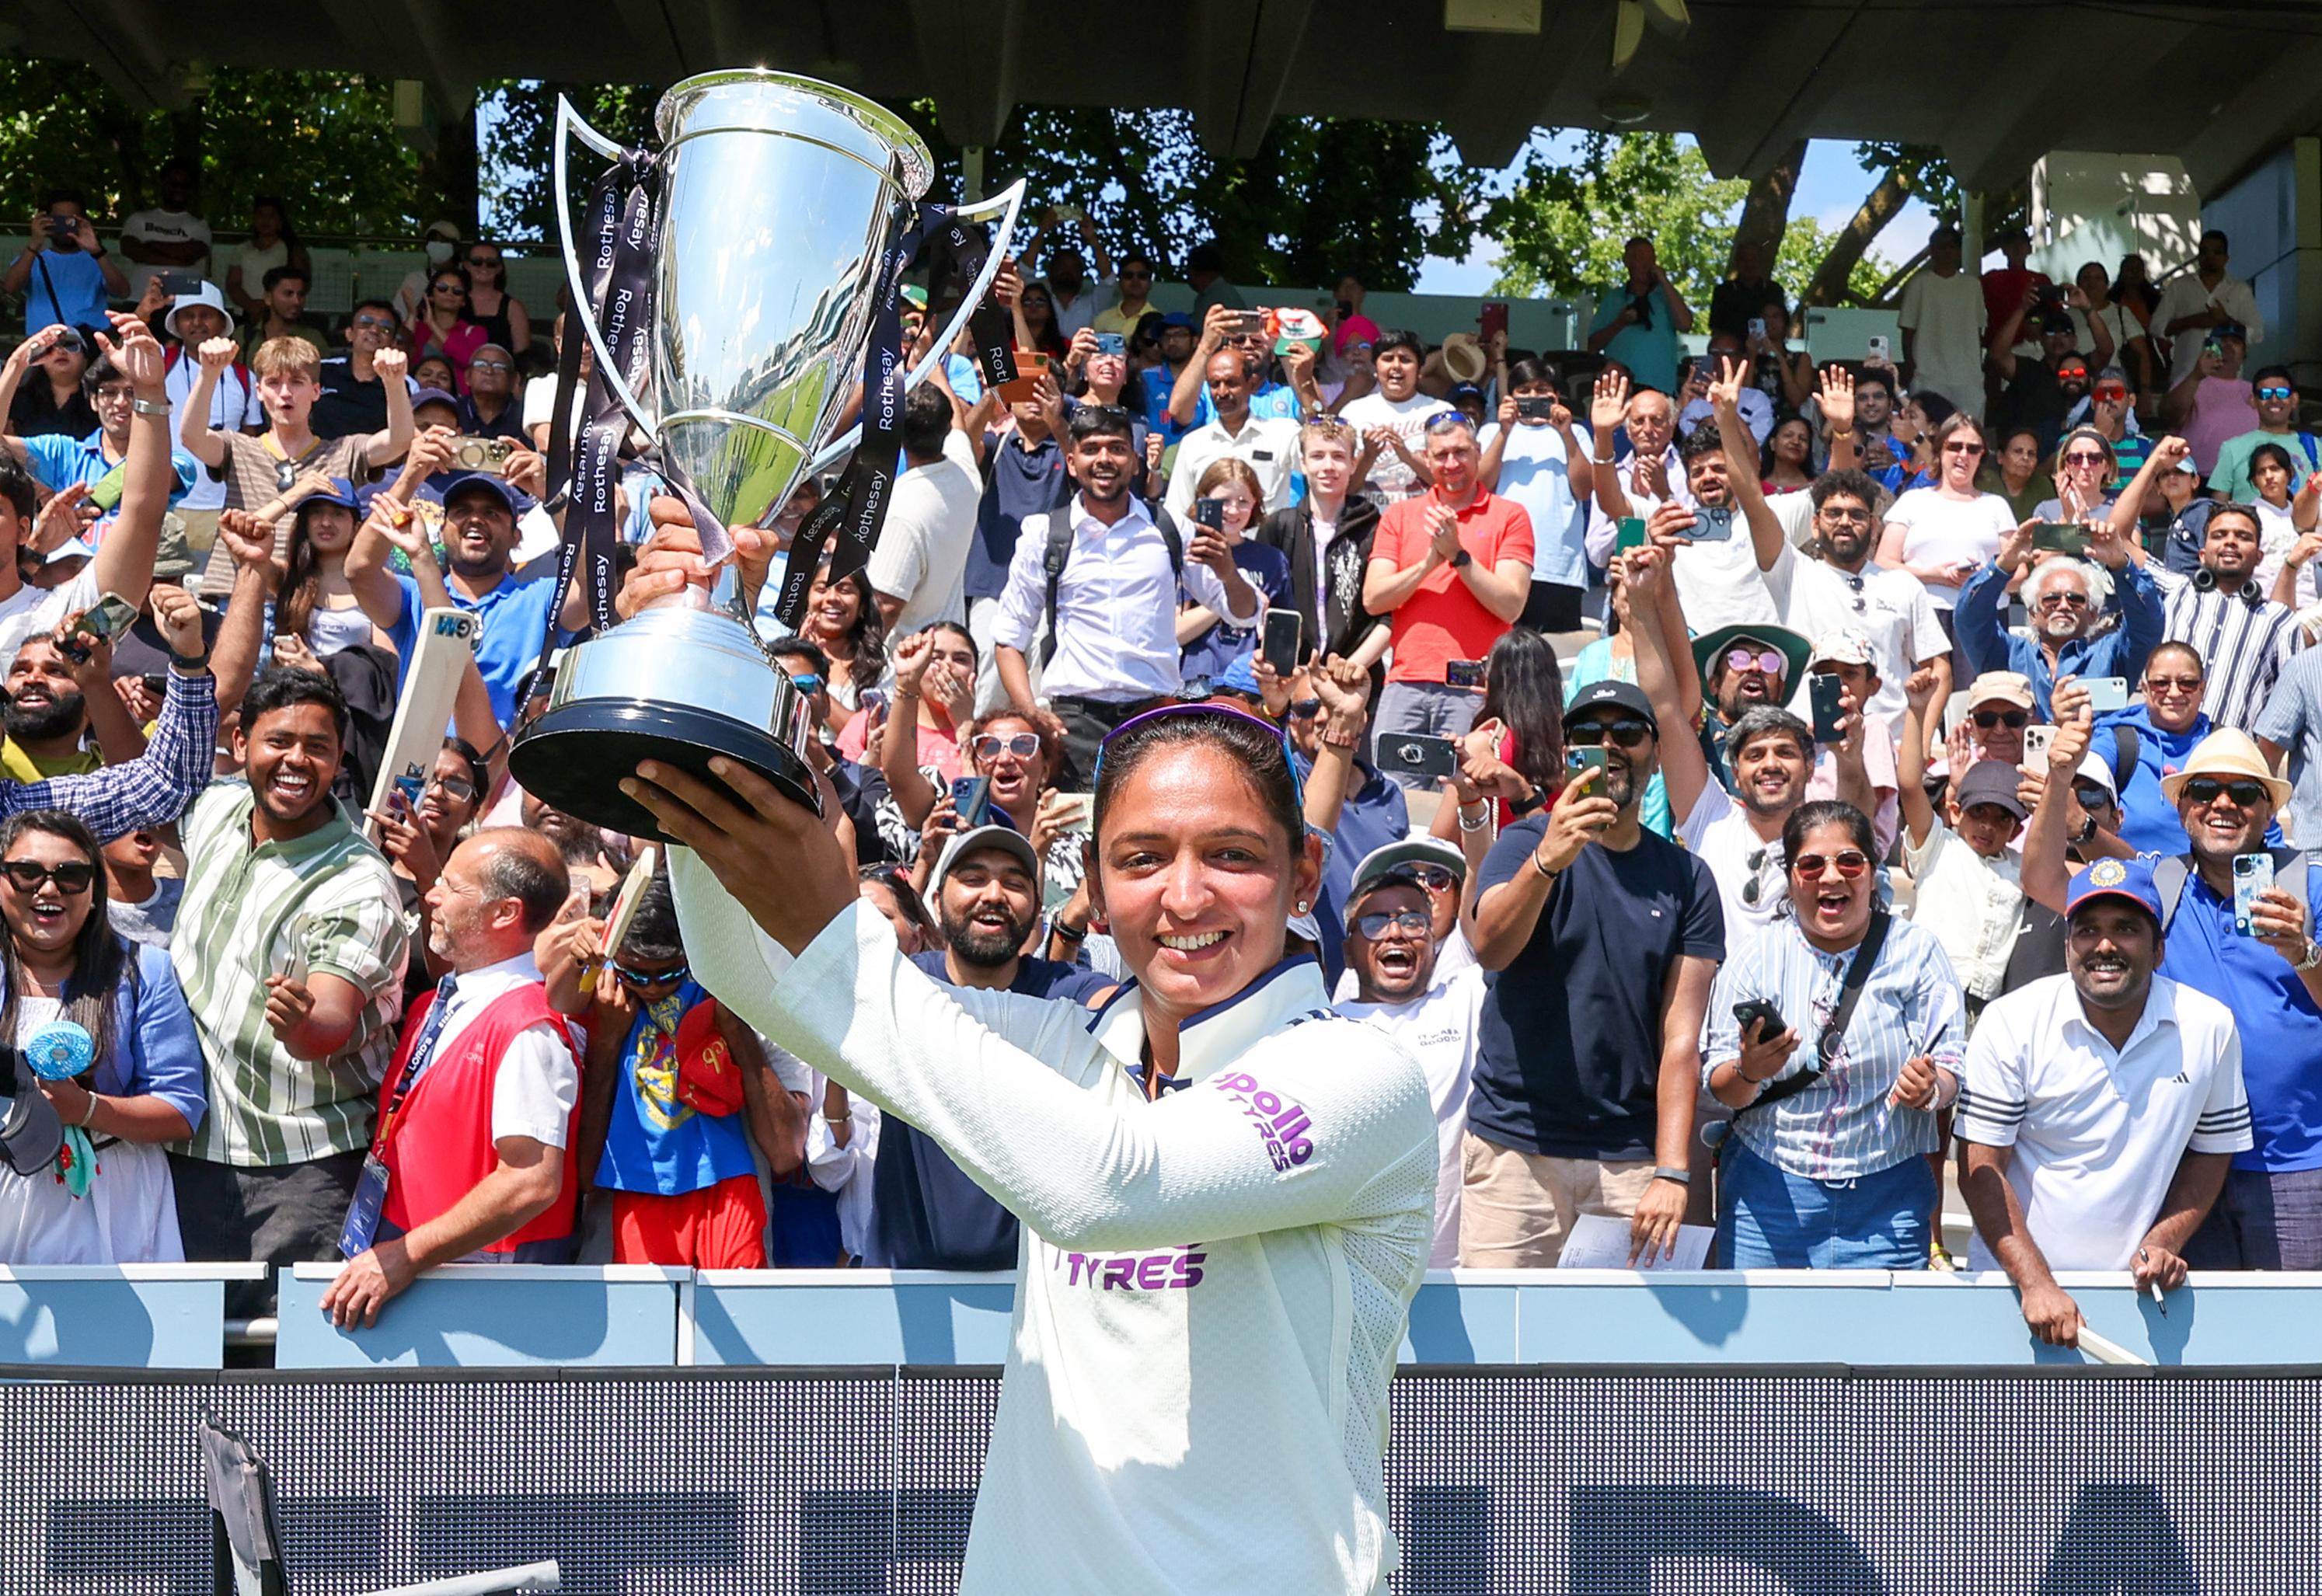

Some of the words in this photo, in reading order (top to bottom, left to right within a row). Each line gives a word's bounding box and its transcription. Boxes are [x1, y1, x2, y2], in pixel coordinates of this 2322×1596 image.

[597, 185, 619, 269] Rothesay
[880, 347, 896, 430] Rothesay
[594, 428, 616, 513] Rothesay
[855, 469, 887, 543] Rothesay
[549, 544, 575, 631] Rothesay
[408, 1037, 433, 1072] LORD'S
[1229, 1094, 1291, 1173] TYRES
[1068, 1253, 1208, 1291] TYRES
